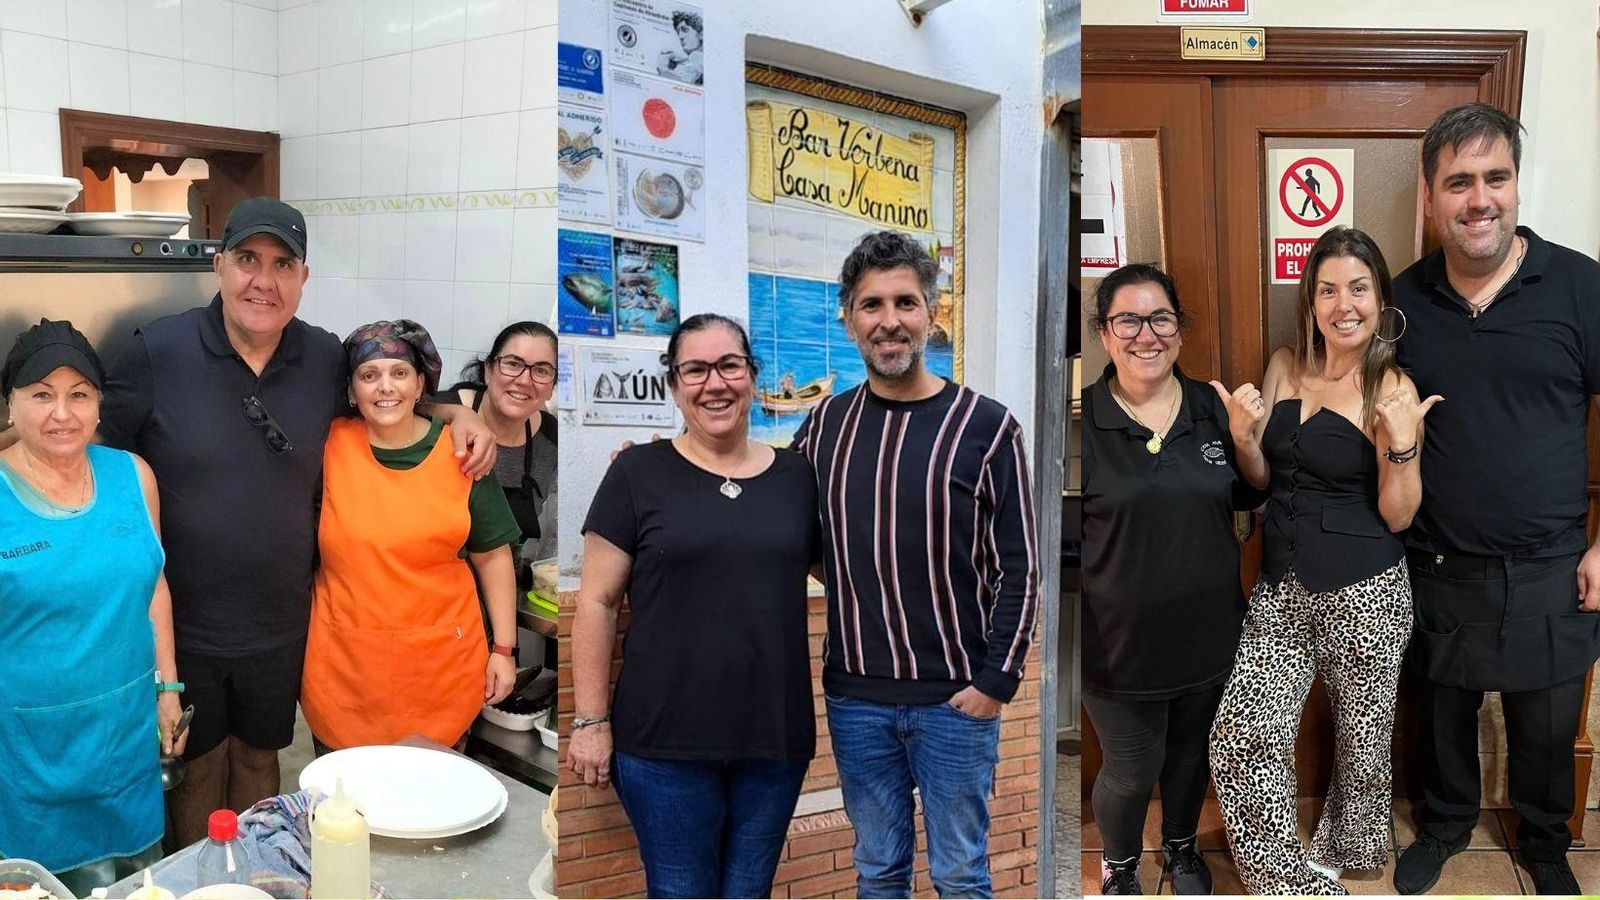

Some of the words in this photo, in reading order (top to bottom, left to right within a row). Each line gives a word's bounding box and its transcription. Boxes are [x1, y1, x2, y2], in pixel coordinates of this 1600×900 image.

[1180, 0, 1229, 9] FUMAR
[1186, 37, 1238, 50] Almacén
[566, 112, 603, 124] ADHERIDO
[778, 108, 832, 158] Bar
[838, 118, 920, 182] Verbena
[776, 148, 832, 204] Casa
[838, 164, 929, 229] Manino
[1277, 242, 1314, 257] PROH
[1087, 257, 1119, 265] EMPRESA
[1286, 260, 1302, 275] EL
[0, 540, 52, 560] BARBARA
